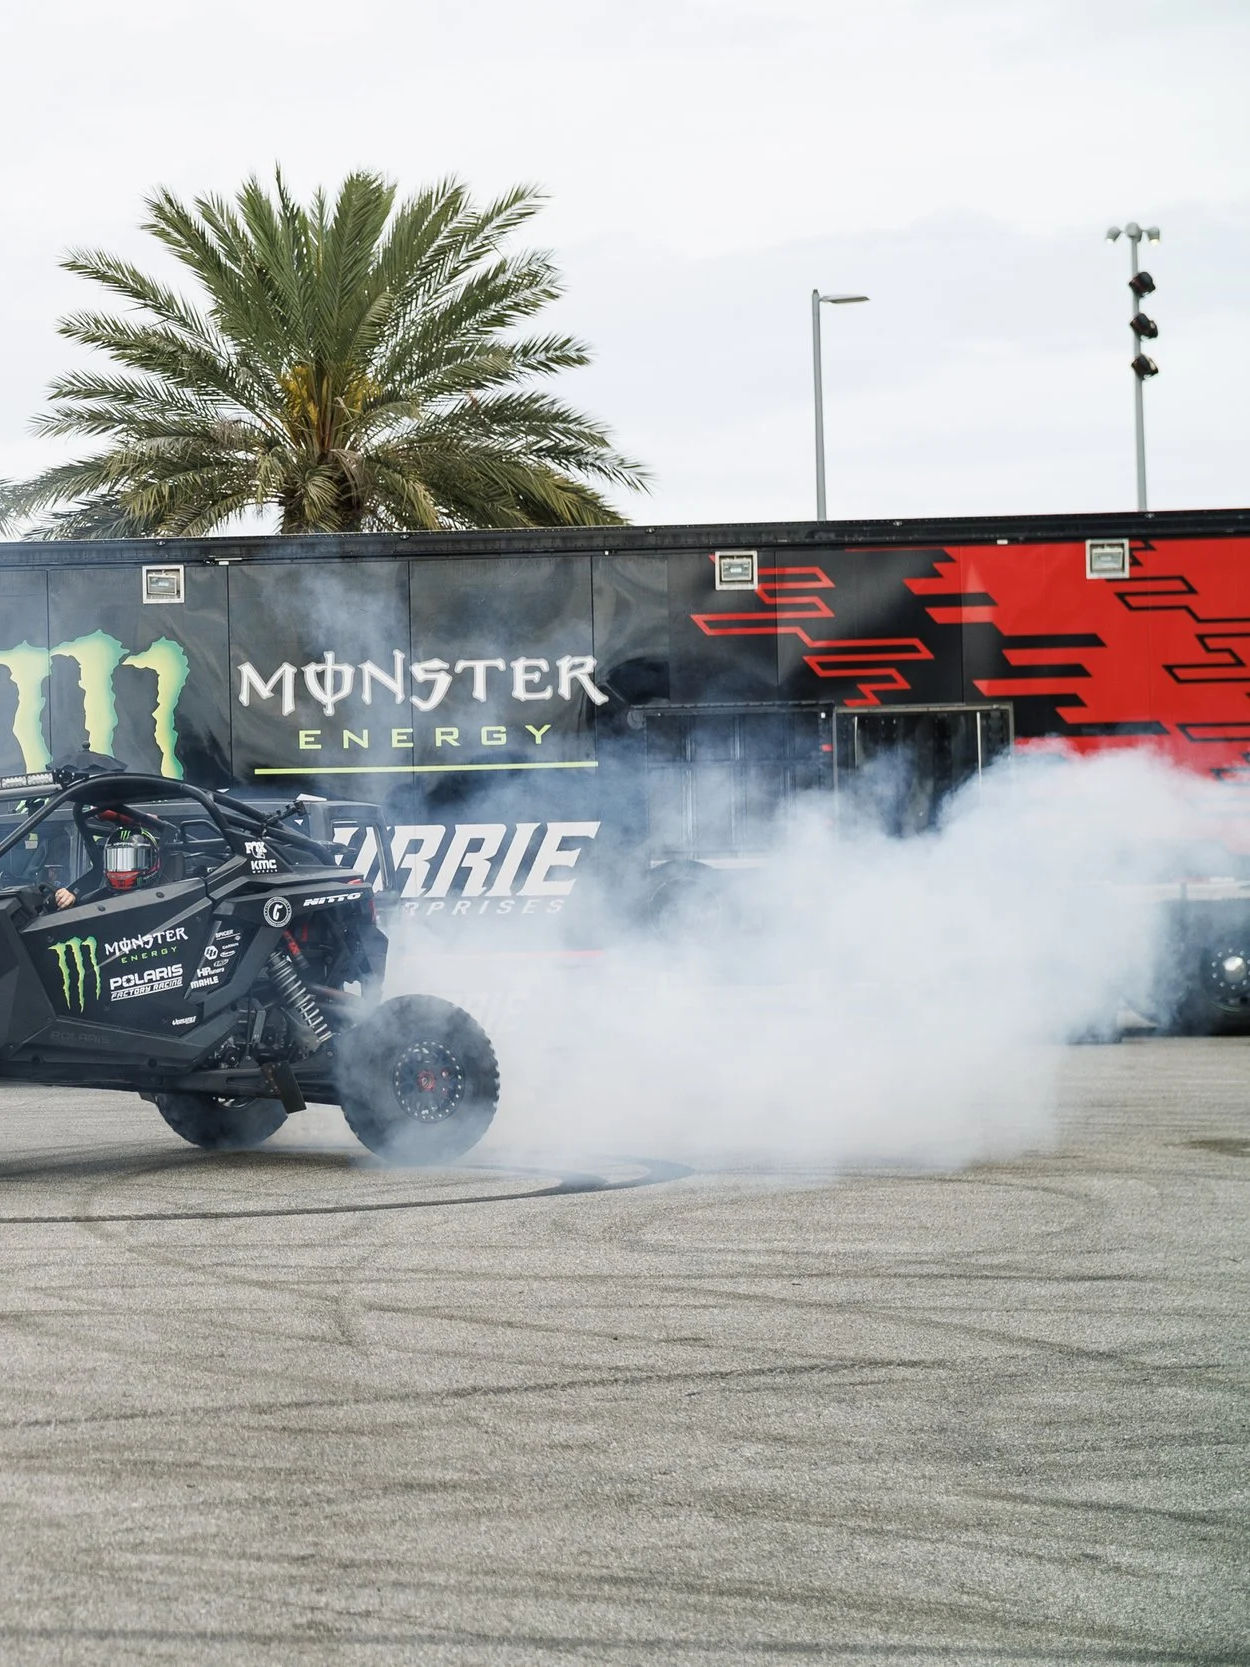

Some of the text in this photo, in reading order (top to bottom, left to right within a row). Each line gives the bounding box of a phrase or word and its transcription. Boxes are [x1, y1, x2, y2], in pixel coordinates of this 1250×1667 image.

[237, 649, 609, 716] MONSTER
[298, 724, 552, 750] ENERGY
[121, 946, 178, 964] ENERGY
[109, 963, 184, 991] POLARIS
